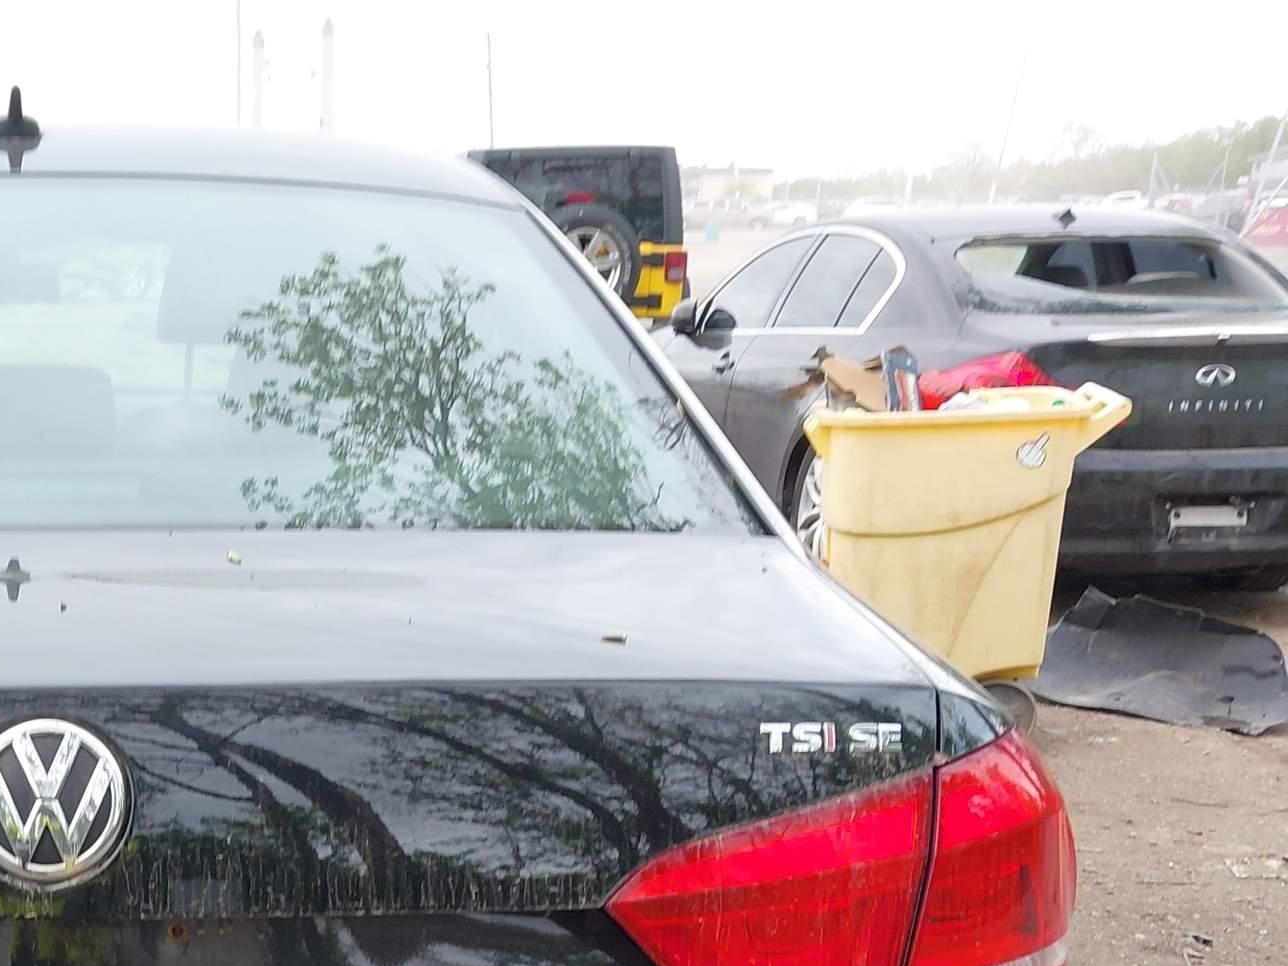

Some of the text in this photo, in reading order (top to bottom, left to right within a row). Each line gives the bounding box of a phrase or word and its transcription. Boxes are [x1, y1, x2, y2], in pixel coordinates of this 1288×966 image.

[1168, 399, 1263, 413] INFINITI
[760, 722, 902, 753] TSI SE
